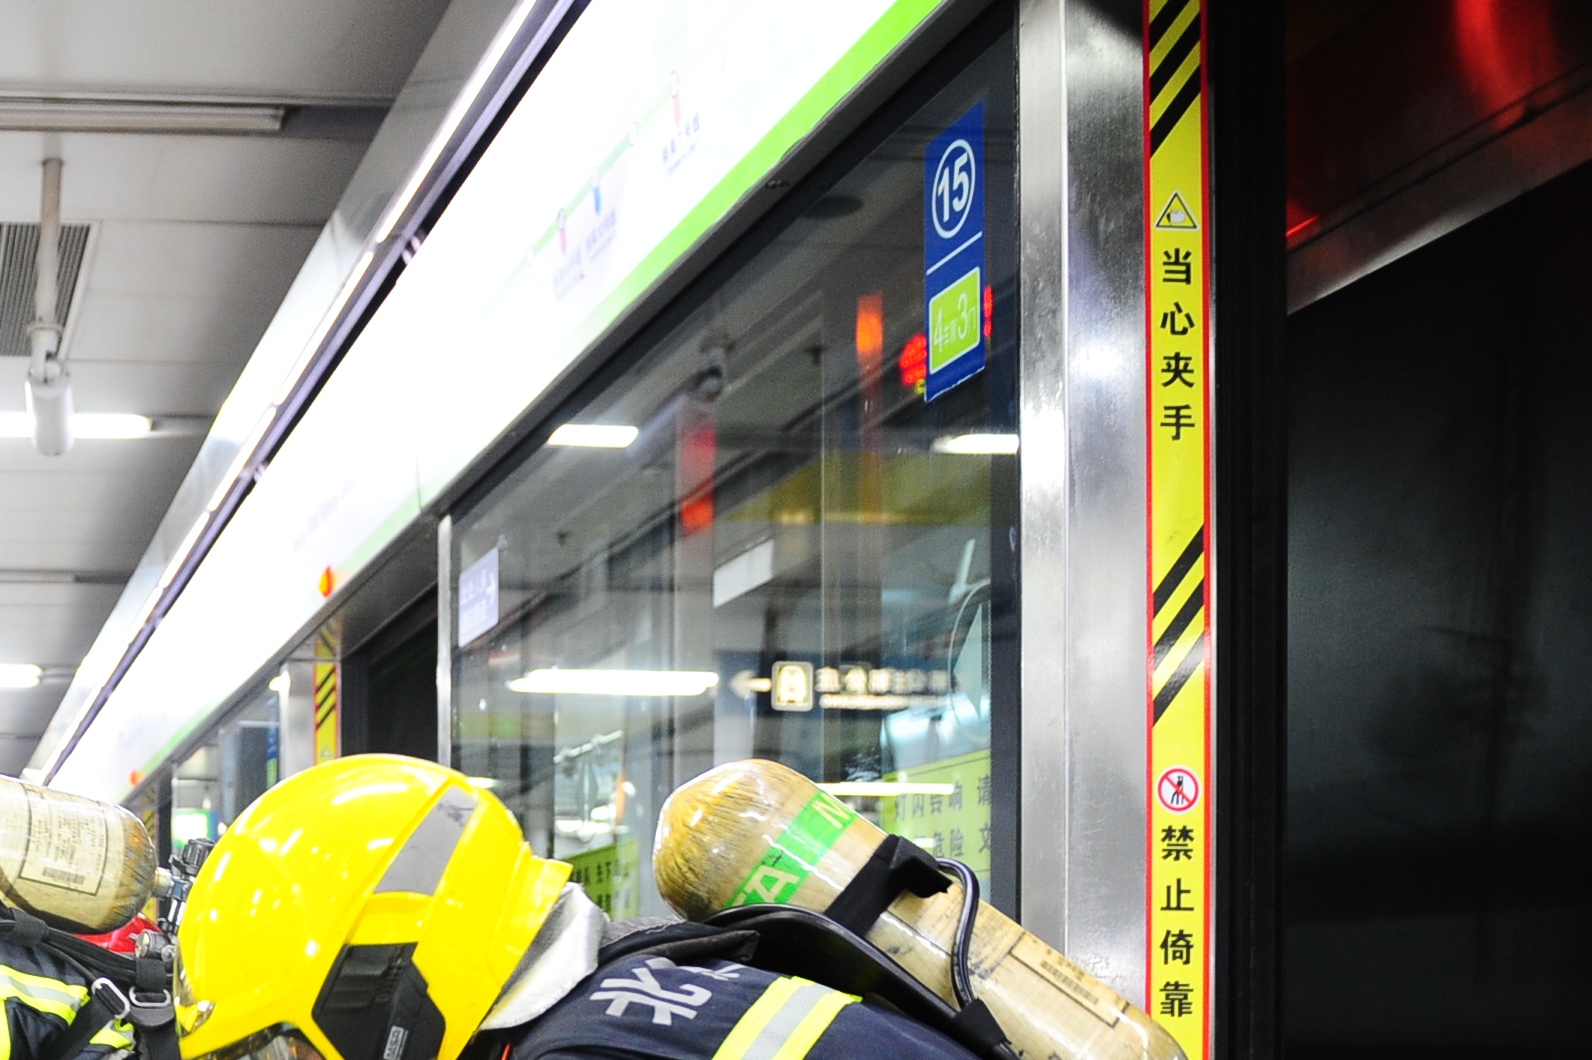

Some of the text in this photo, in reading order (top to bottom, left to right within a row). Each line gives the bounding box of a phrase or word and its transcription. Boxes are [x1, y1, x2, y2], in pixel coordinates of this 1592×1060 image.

[937, 151, 970, 223] 15
[1160, 247, 1196, 441] 当心夹手
[1159, 825, 1195, 1018] 禁止倚靠
